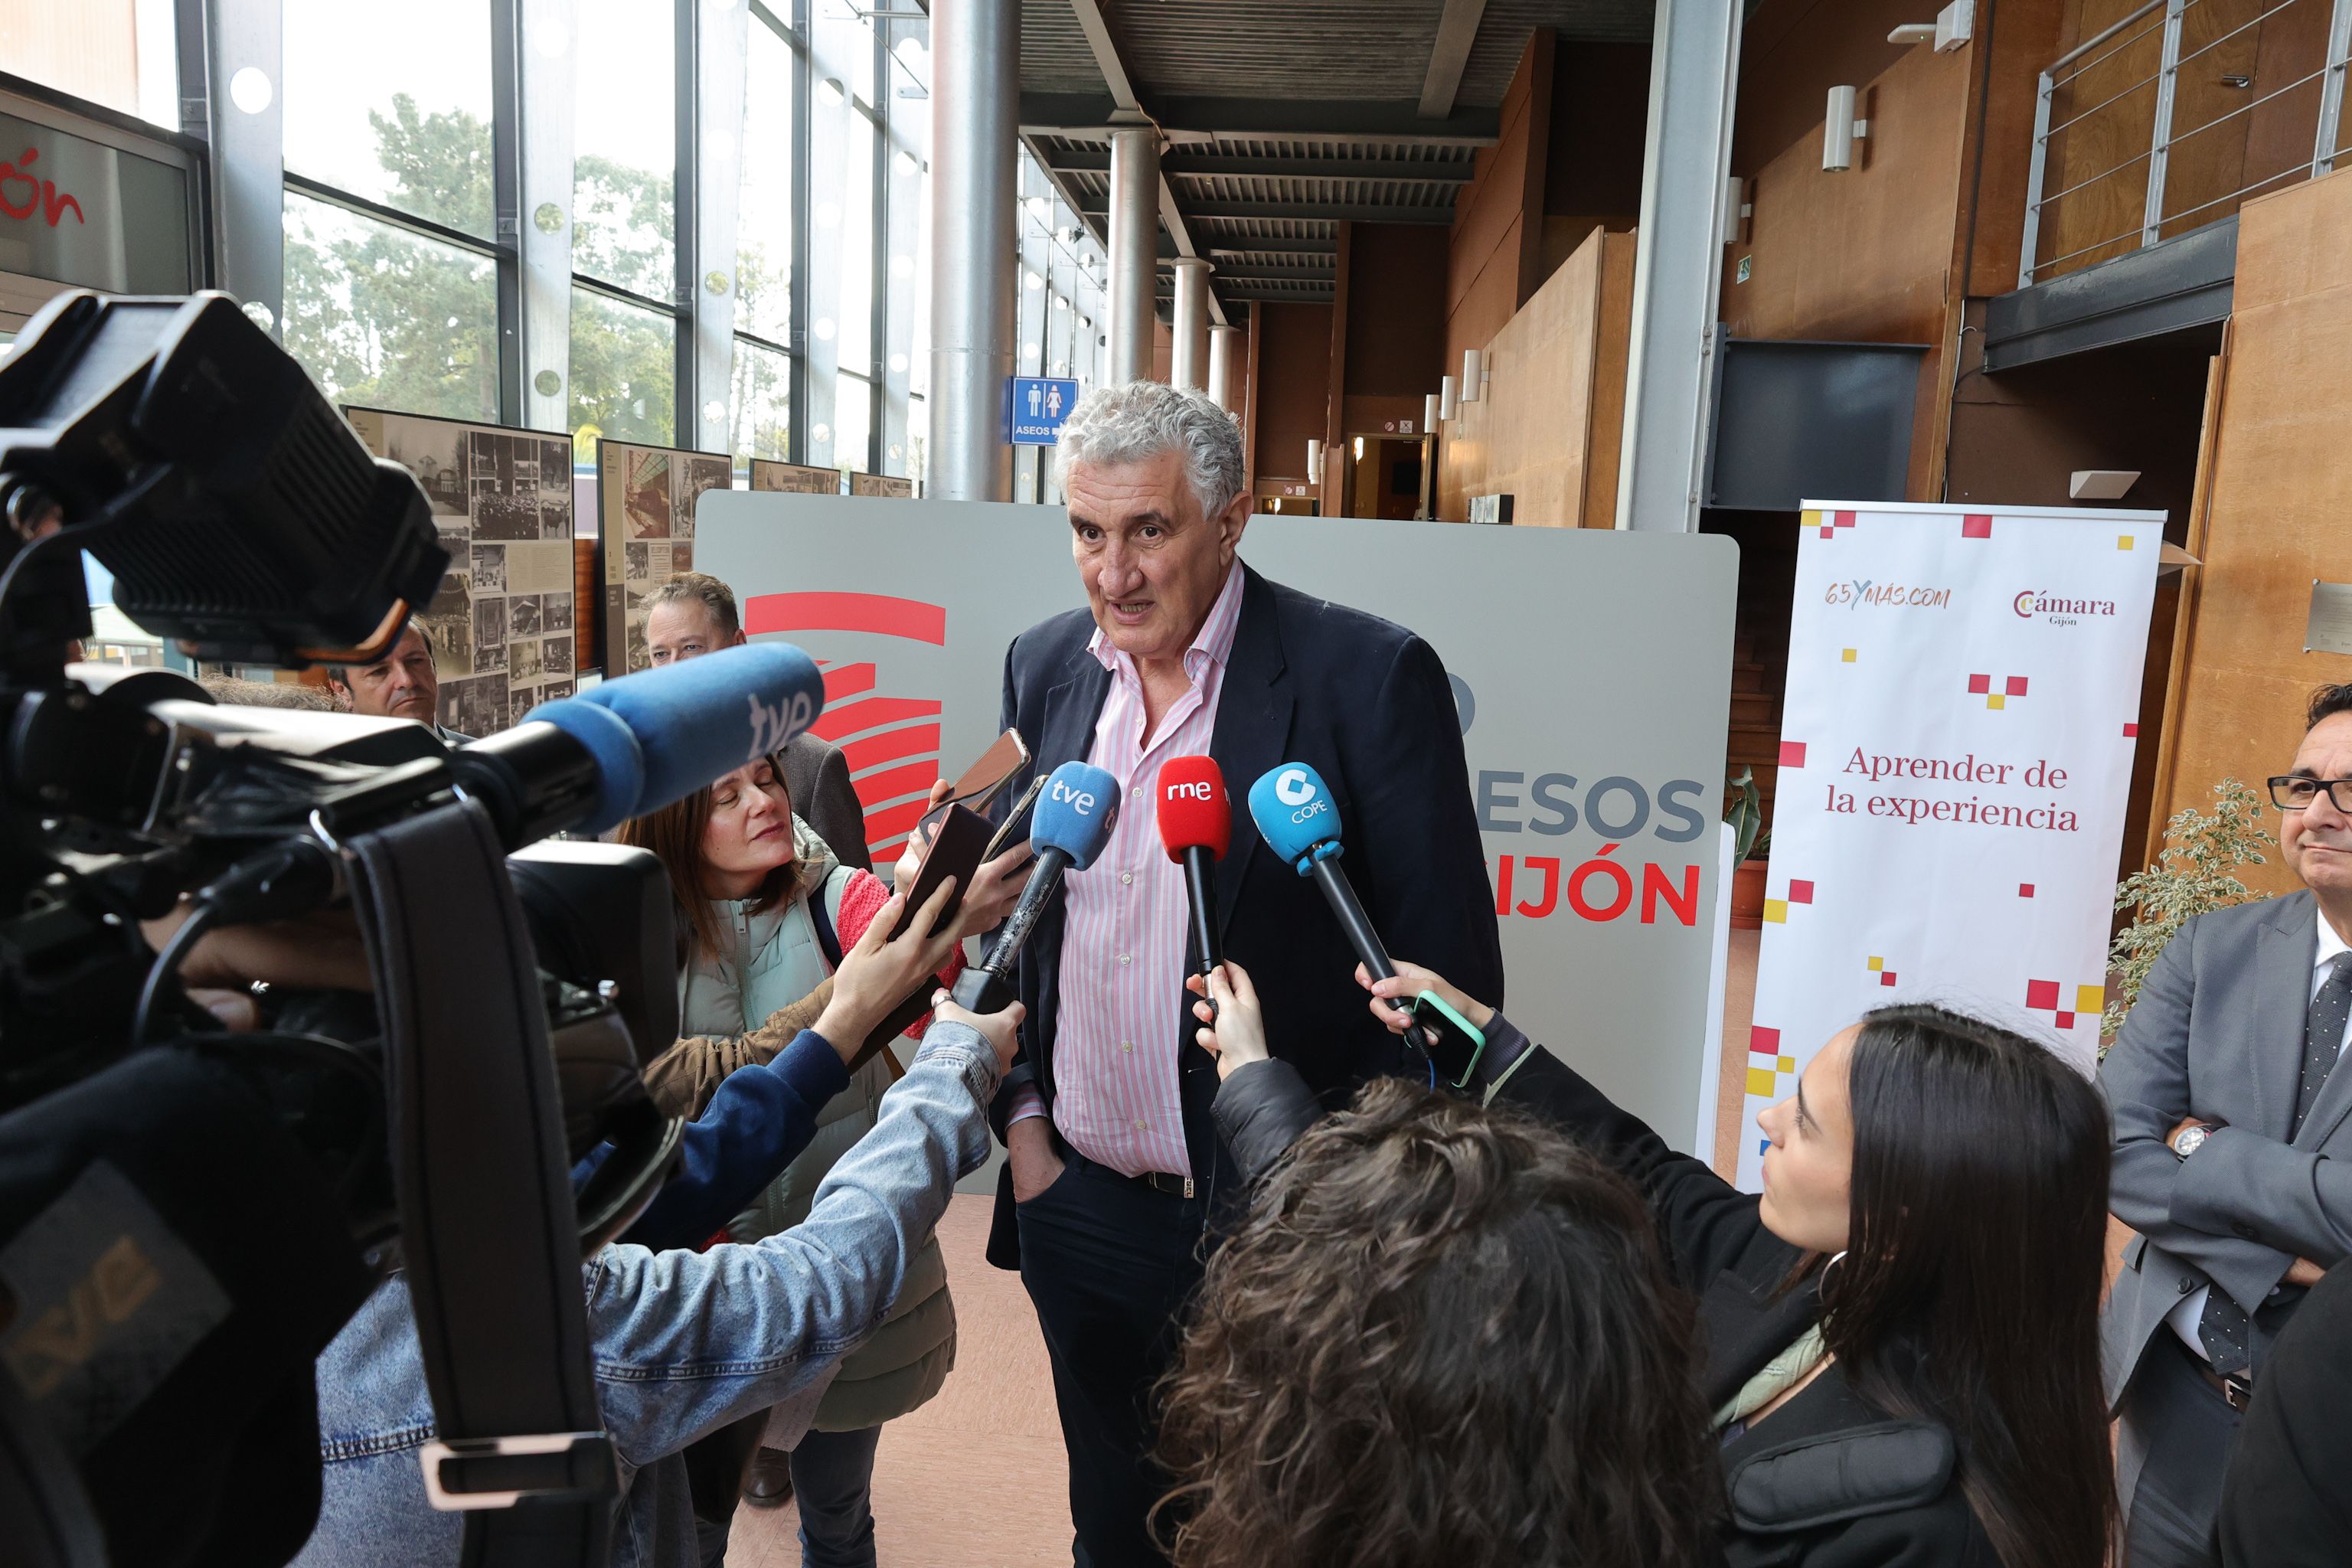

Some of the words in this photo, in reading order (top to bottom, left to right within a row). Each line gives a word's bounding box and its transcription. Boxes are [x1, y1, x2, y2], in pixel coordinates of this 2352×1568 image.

[0, 147, 85, 227] ón
[1015, 425, 1050, 436] ASEOS
[2049, 616, 2077, 628] Gijón
[1842, 746, 2014, 785] Aprender
[2024, 760, 2068, 789] de
[1051, 779, 1096, 816] tve
[1167, 779, 1212, 802] rne
[1475, 769, 1706, 843] ESOS
[1824, 784, 1857, 814] la
[1867, 795, 2079, 831] experiencia
[1291, 799, 1328, 825] COPE
[1485, 843, 1700, 926] IJÓN
